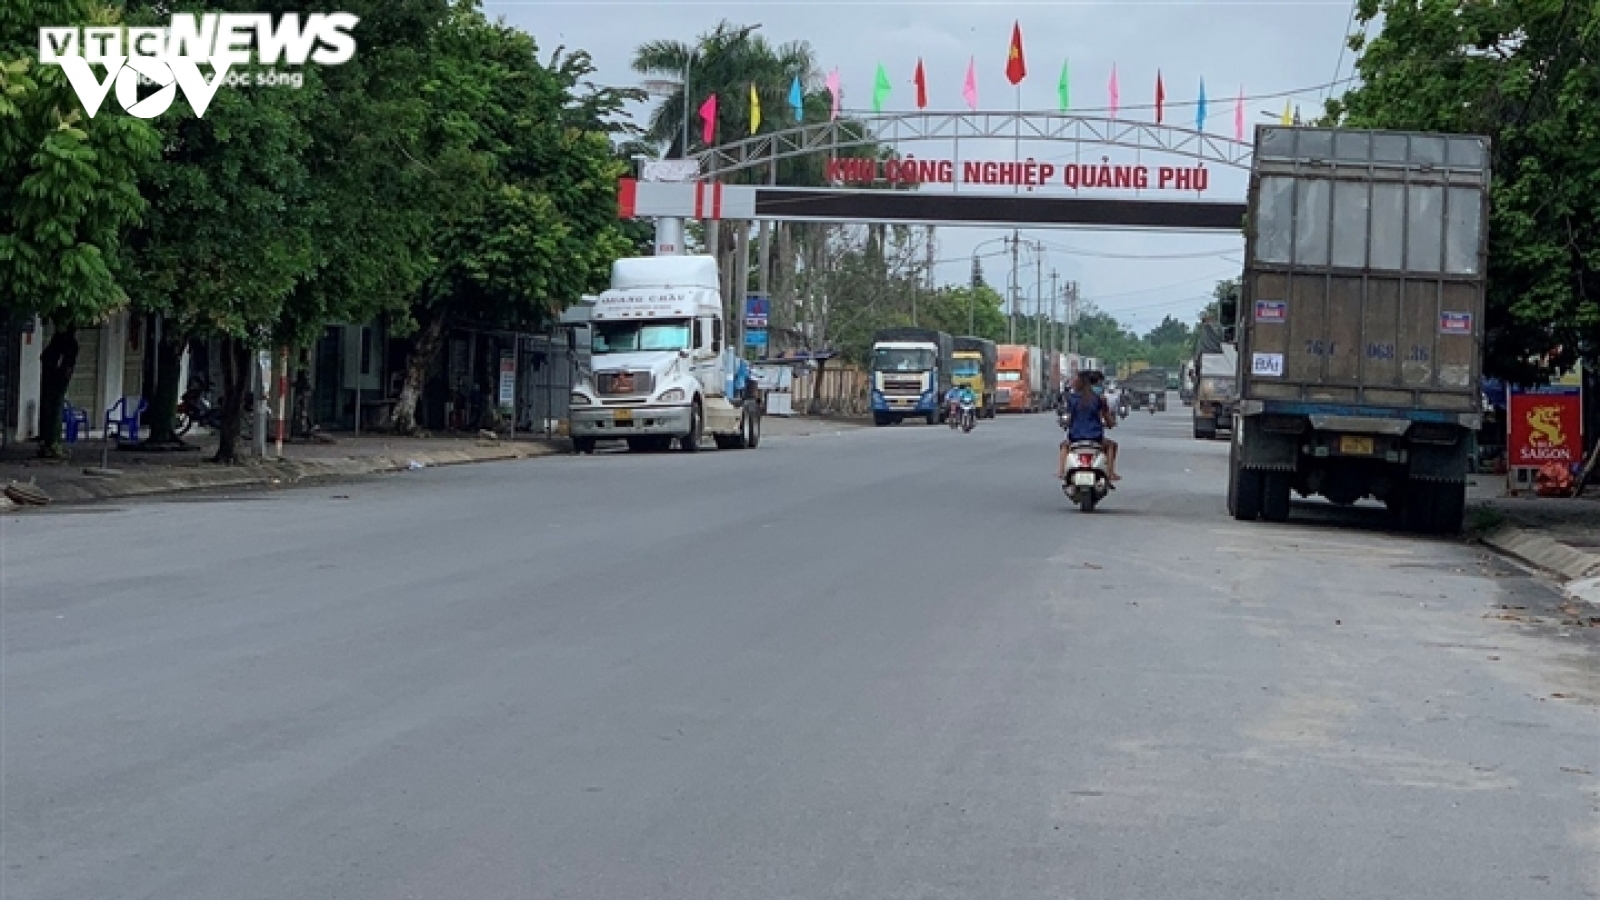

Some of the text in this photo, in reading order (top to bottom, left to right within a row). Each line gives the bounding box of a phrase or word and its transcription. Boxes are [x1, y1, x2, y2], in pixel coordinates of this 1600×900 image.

[826, 153, 1208, 192] KHU CÔNG NGHIỆP QUẢNG PHÚ
[1520, 447, 1570, 459] SAIGON
